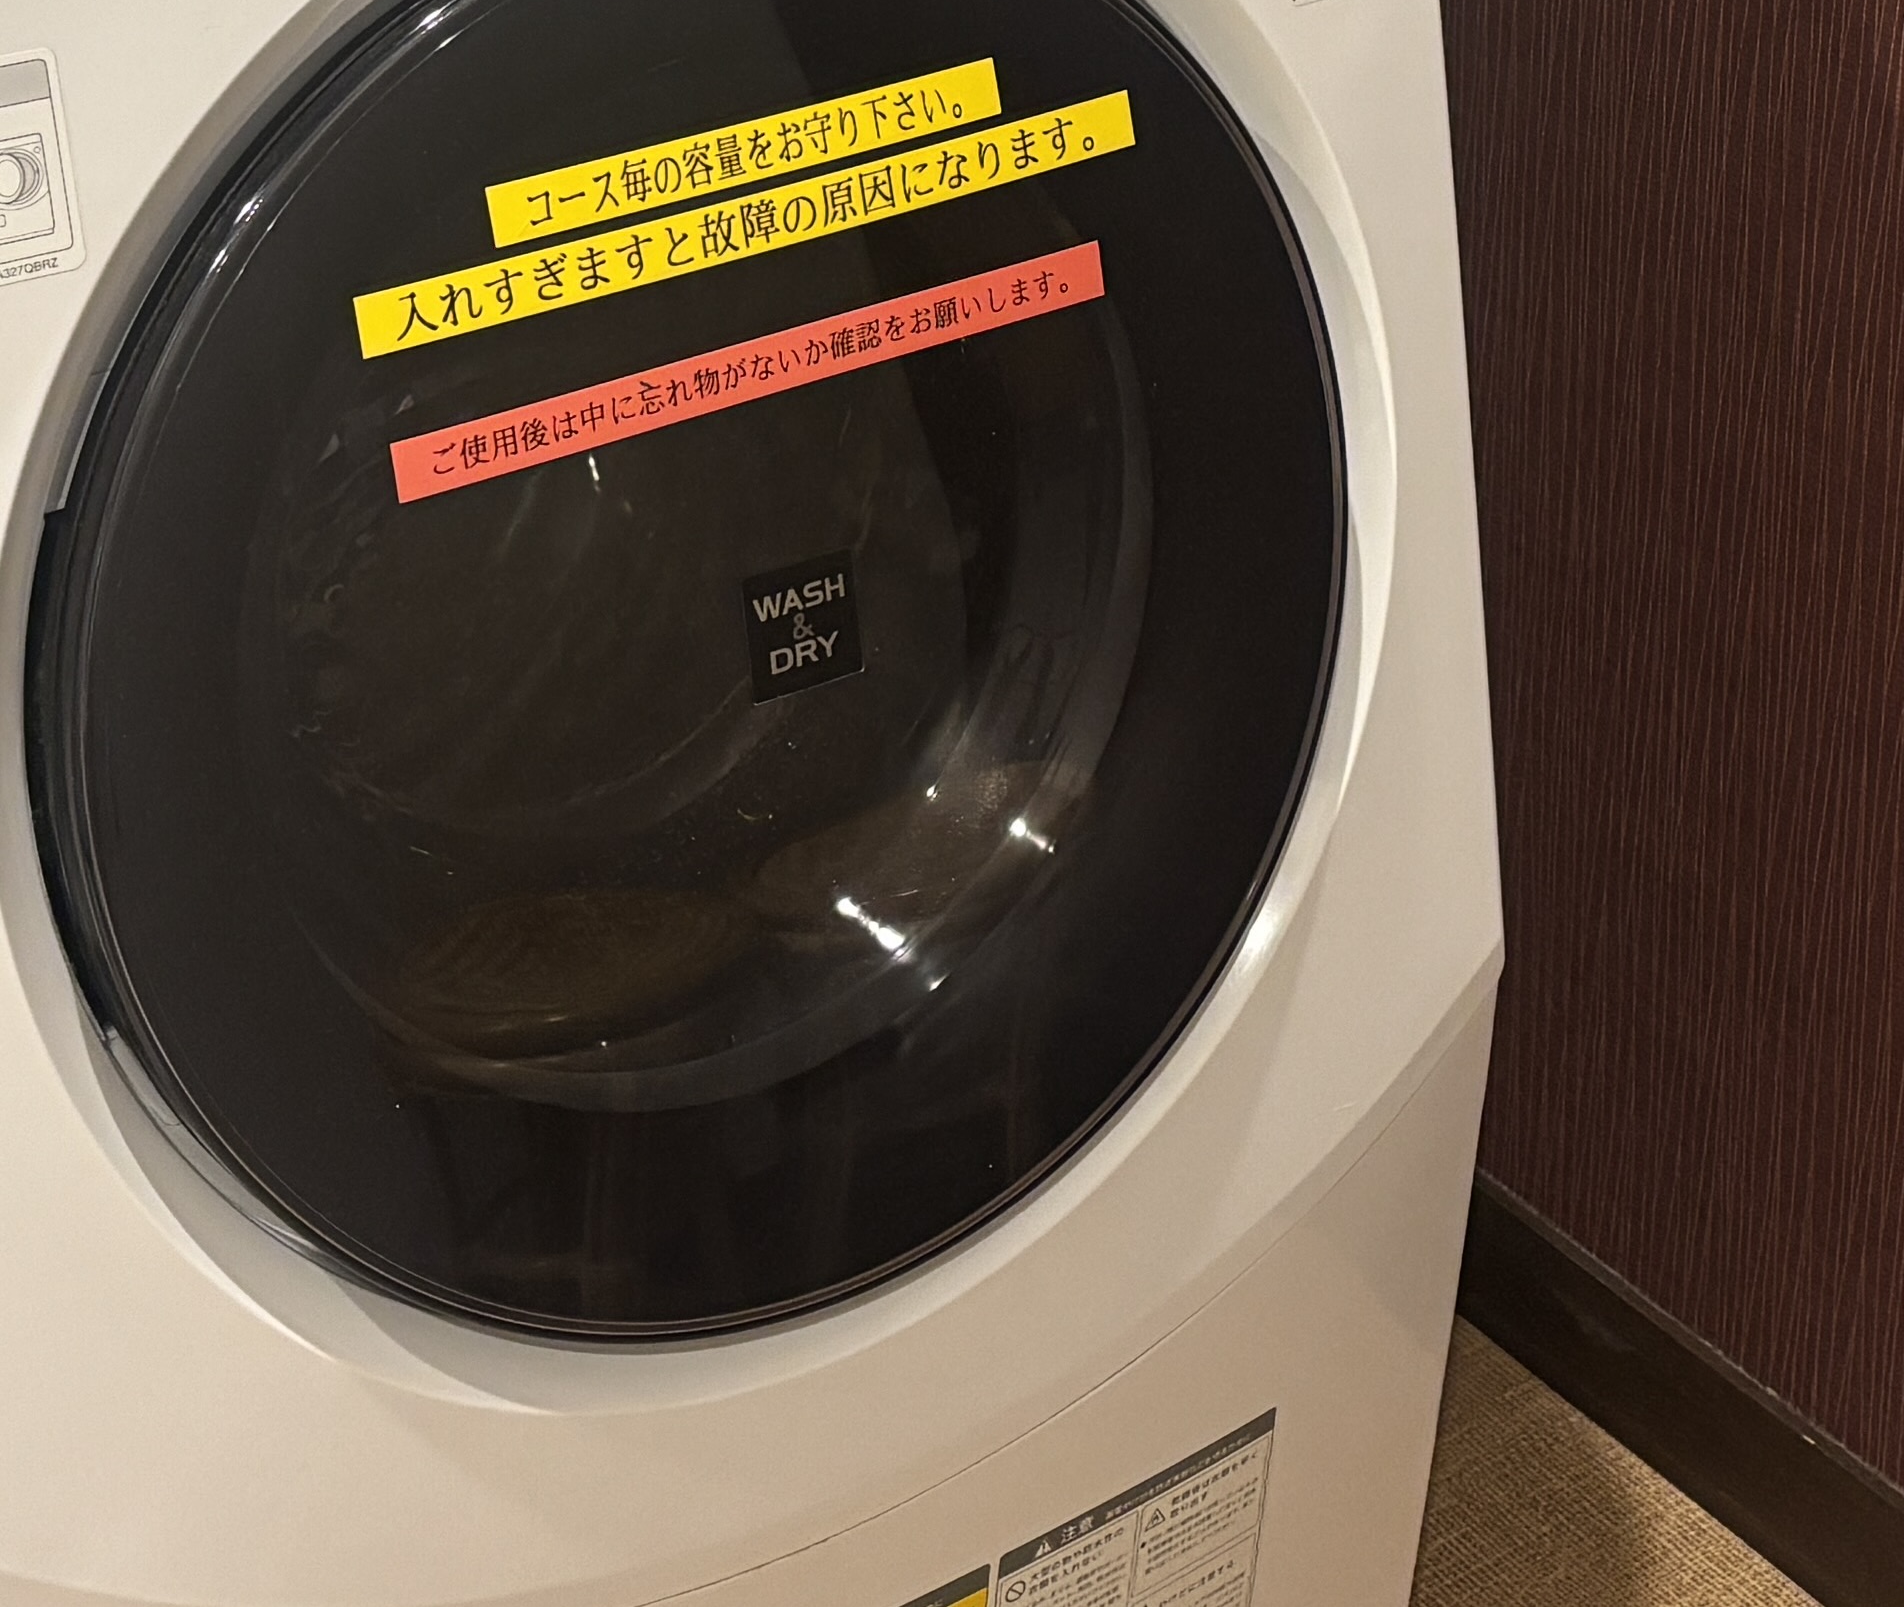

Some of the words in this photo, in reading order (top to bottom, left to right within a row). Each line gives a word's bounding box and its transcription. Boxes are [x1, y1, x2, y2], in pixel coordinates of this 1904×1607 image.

[527, 91, 967, 228] コース毎の容量をお守り下さい。
[396, 116, 1096, 342] 入れすぎますと故障の原因になります。
[432, 270, 1070, 476] ご使用後は中に忘れ物がないか確認をお願いします。
[752, 573, 845, 623] WASH
[792, 612, 815, 639] &
[769, 630, 839, 675] DRY
